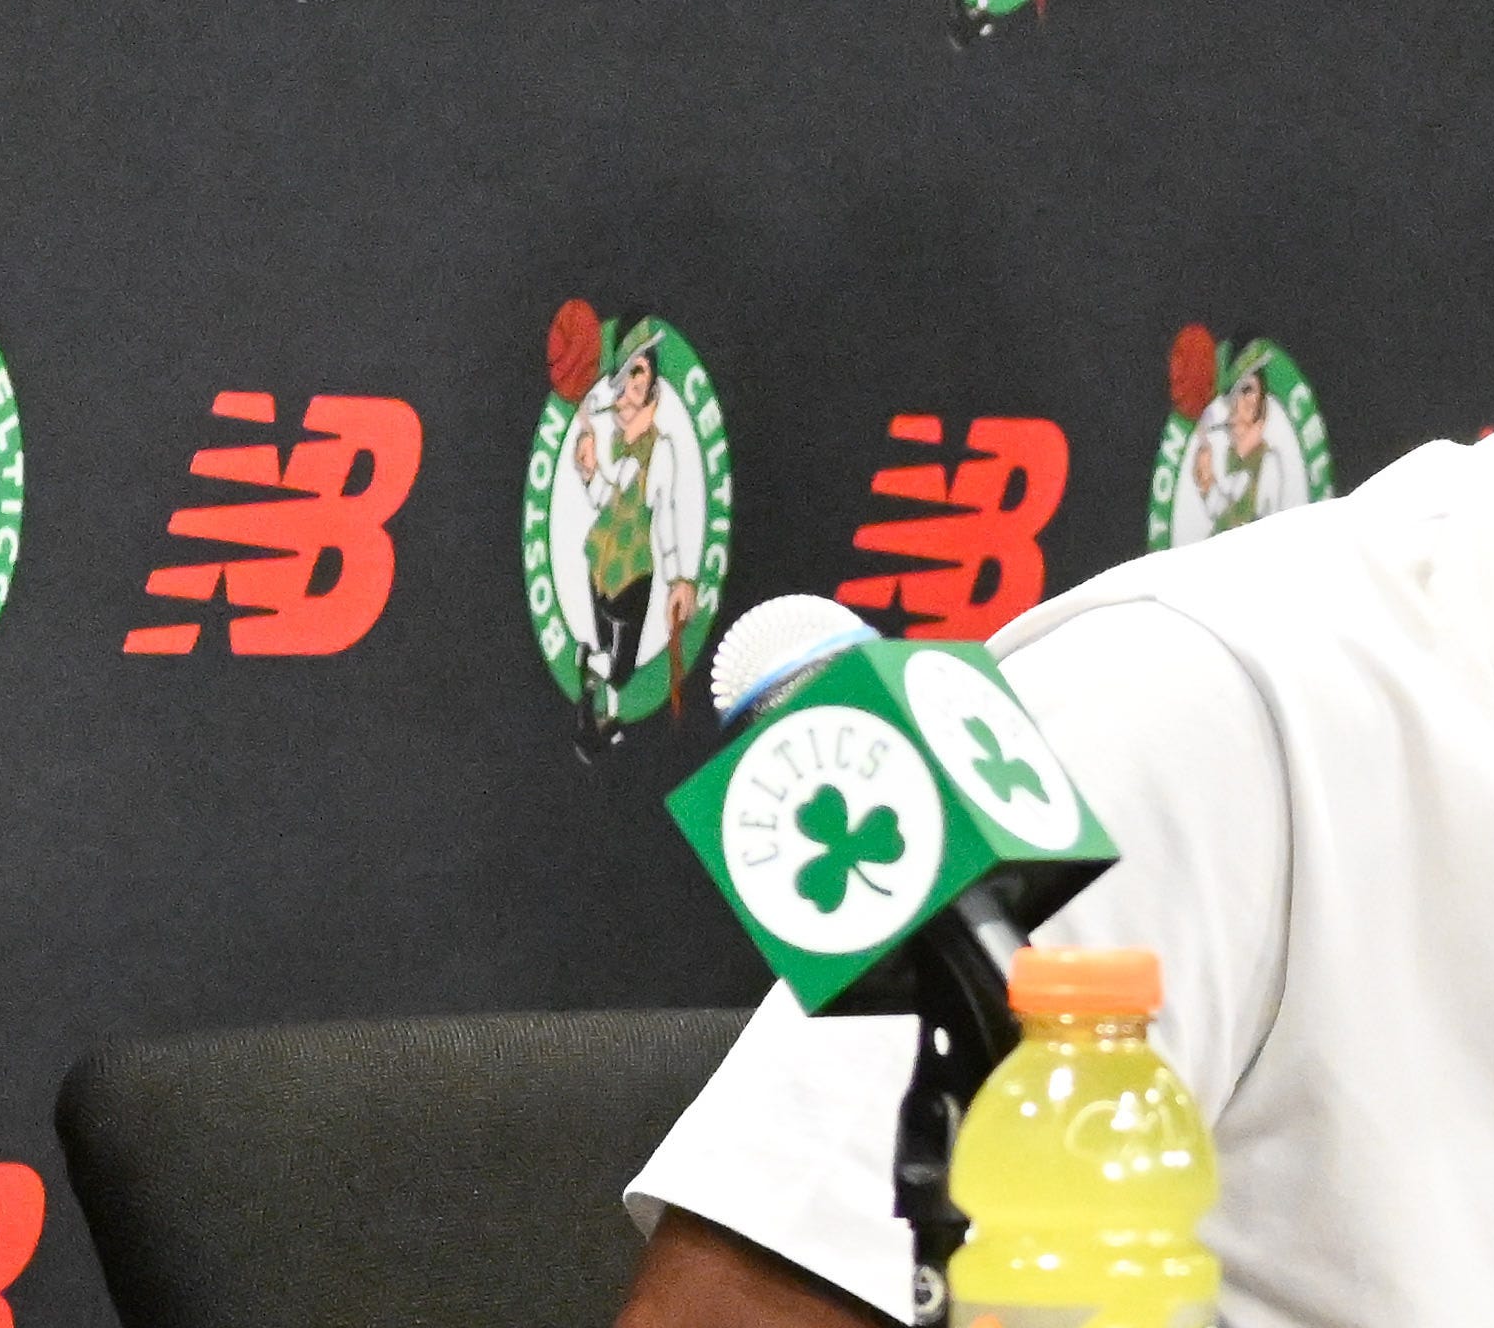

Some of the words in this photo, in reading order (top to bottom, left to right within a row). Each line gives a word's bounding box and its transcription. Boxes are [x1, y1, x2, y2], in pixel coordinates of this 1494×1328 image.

[524, 405, 567, 662] BOSTON
[685, 368, 731, 614] CELTICS
[739, 725, 890, 868] CELTICS
